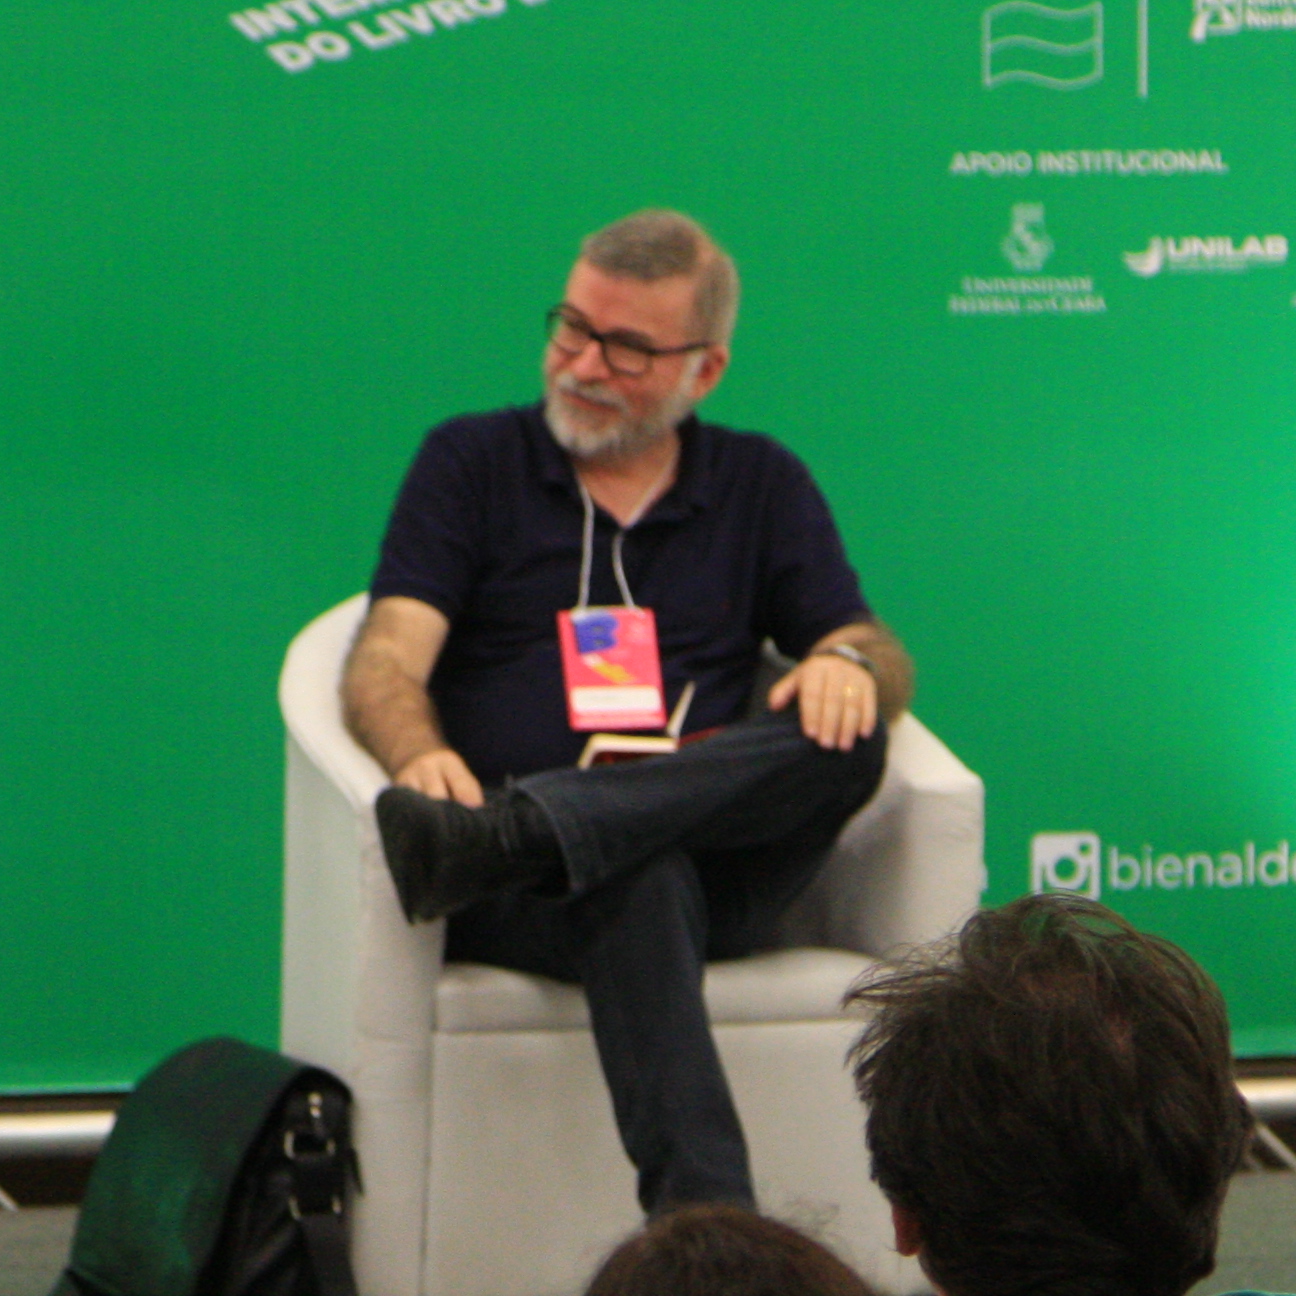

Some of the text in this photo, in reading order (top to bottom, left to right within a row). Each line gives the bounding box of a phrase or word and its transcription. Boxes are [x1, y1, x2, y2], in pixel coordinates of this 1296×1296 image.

[266, 0, 505, 73] DO LIVRO
[949, 148, 1229, 176] APOIO INSTITUCIONAL
[1167, 234, 1289, 259] UNILAB
